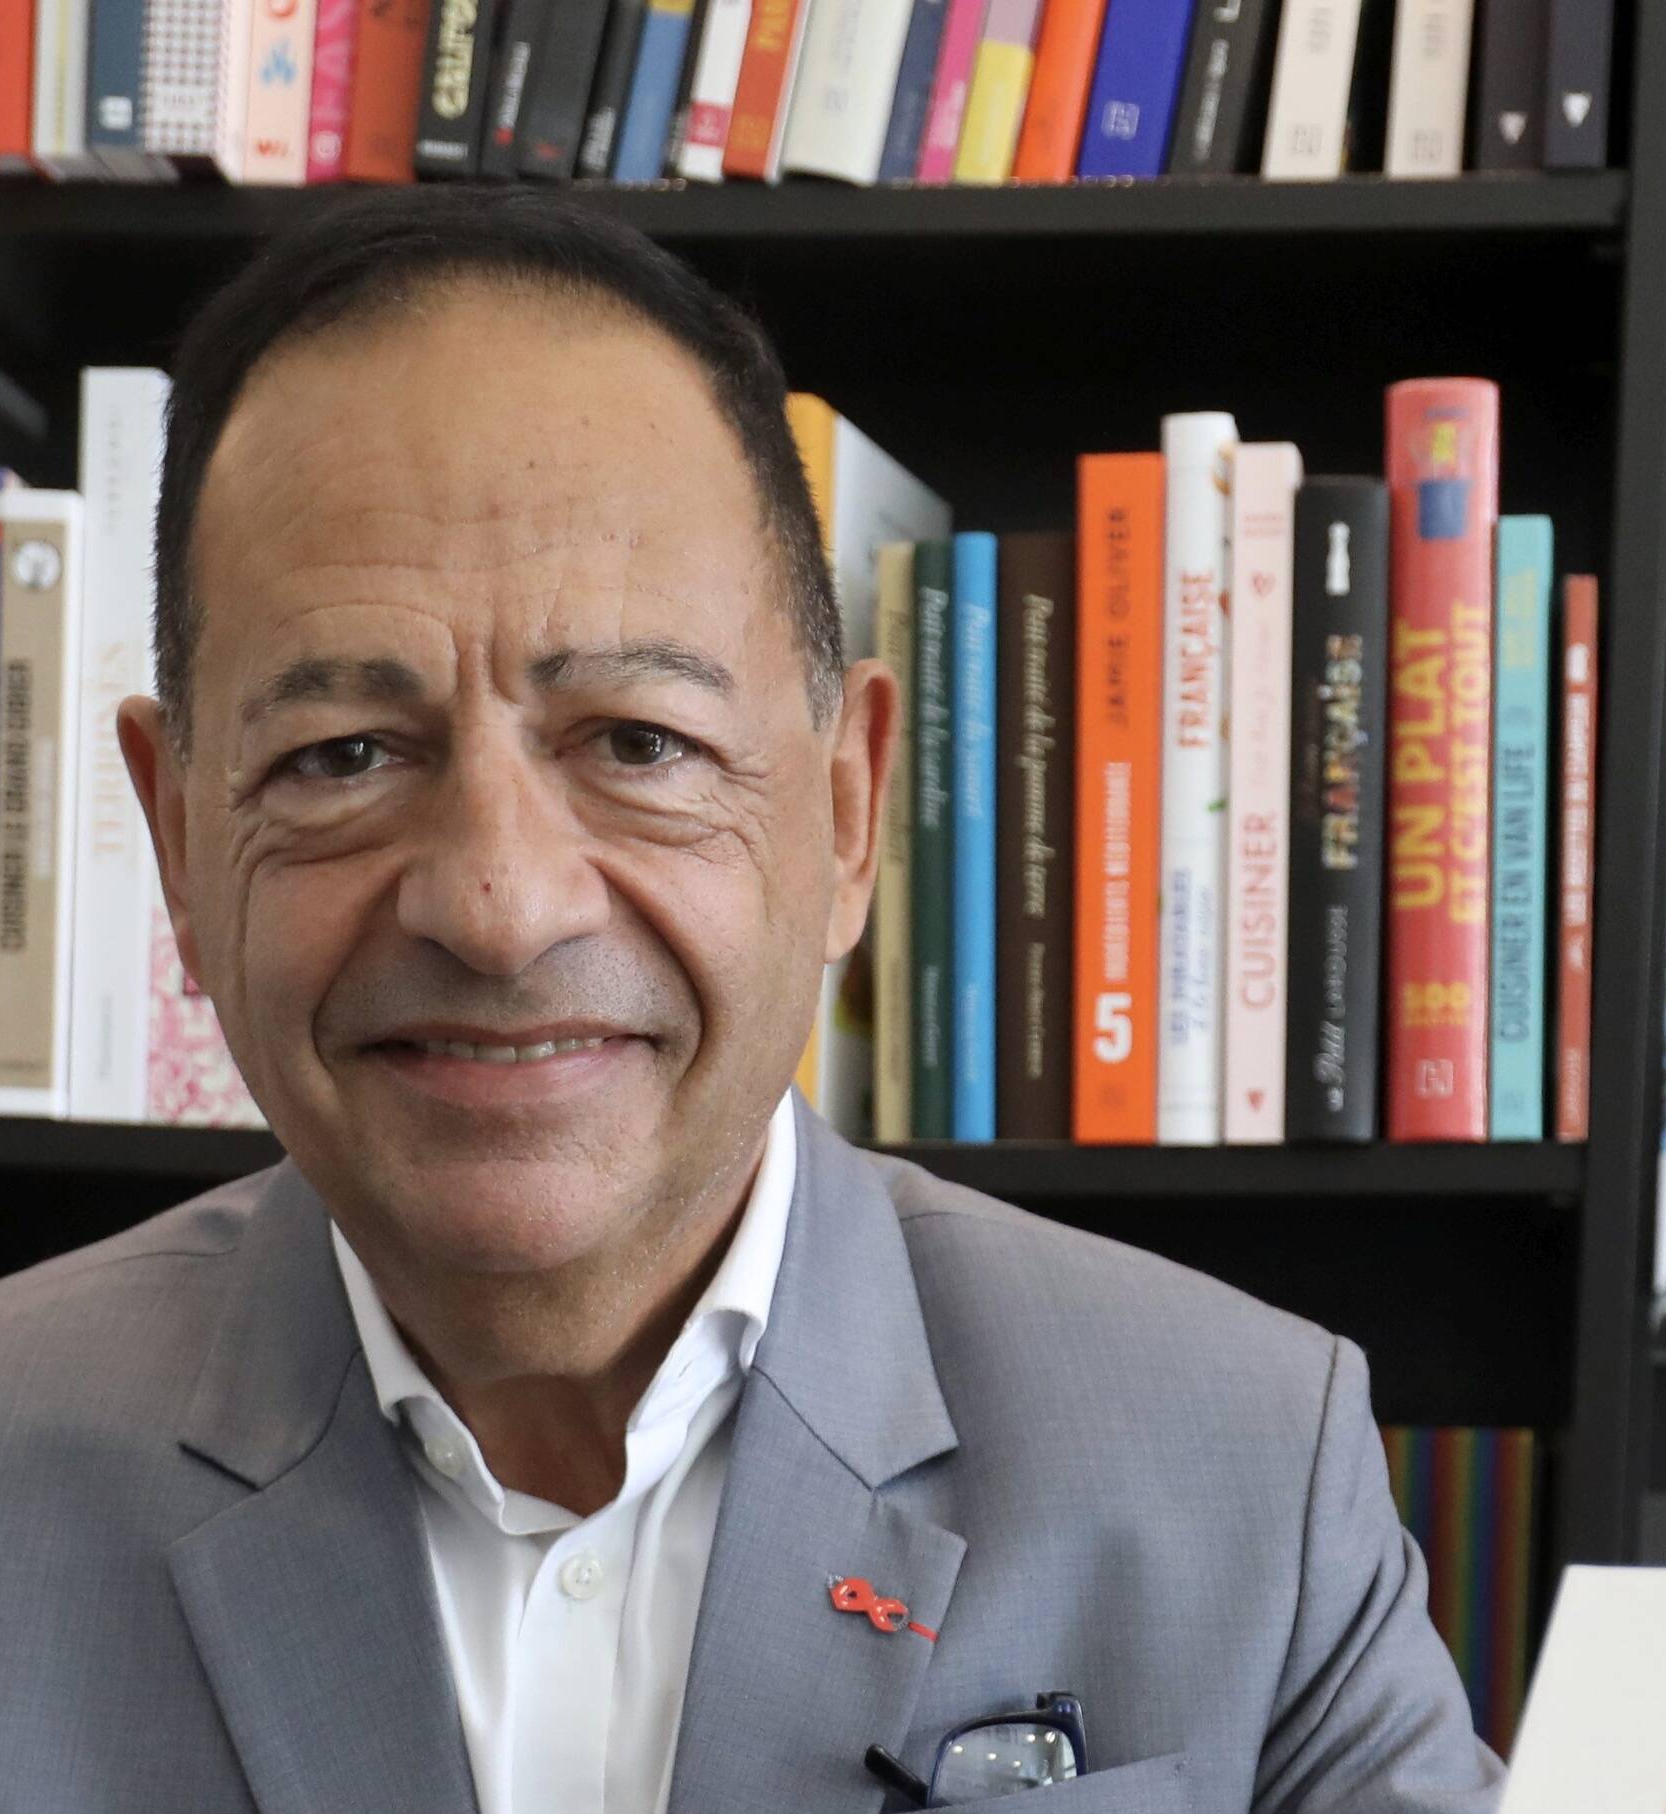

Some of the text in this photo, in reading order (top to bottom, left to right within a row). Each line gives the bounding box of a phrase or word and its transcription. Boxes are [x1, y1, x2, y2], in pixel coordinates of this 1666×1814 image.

[920, 586, 950, 636] Petit
[1021, 594, 1056, 643] Petit
[1106, 509, 1130, 732] JAMIE OLIVER
[1176, 568, 1218, 750] FRANÇAISE
[1320, 634, 1369, 870] FRANÇAISE
[1394, 617, 1447, 911] UN PLAT
[1450, 601, 1489, 927] ET C'EST TOUT
[1237, 808, 1279, 1014] CUISINER
[1498, 742, 1536, 1046] CUISINER EN VAN LIFE
[1093, 992, 1132, 1064] 5
